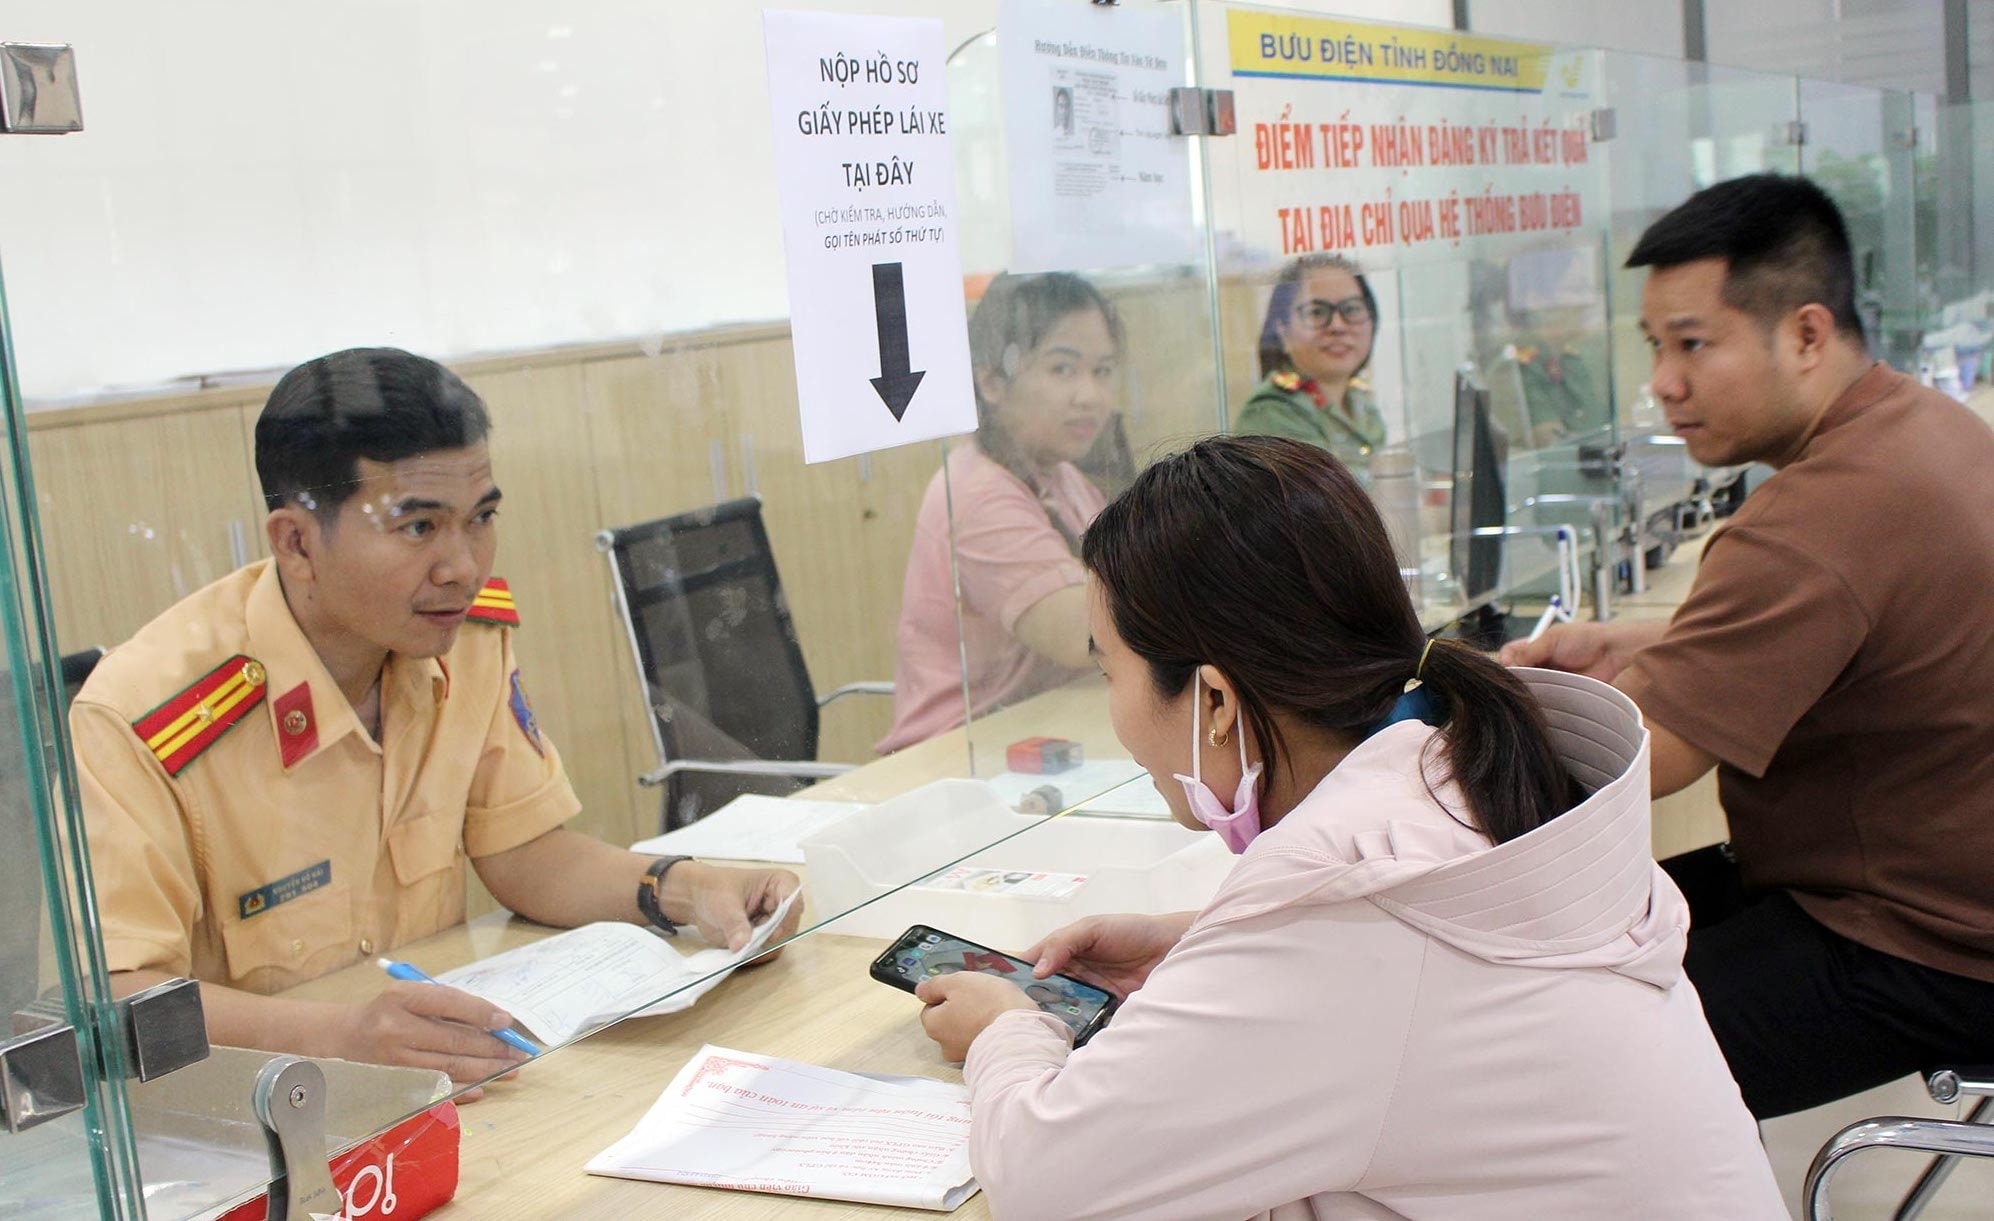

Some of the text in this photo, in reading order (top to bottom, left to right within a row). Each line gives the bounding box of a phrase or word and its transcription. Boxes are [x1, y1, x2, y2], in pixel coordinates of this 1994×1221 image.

[819, 50, 920, 88] NỘP HỒ SƠ
[1260, 33, 1519, 77] BƯU ĐIỆN TỈNH ĐỒNG NAI
[798, 101, 946, 135] GIẤY PHÉP LÁI XE
[1256, 103, 1314, 170] ĐIỂM
[1320, 109, 1363, 169] TIẾP
[1371, 116, 1424, 176] NHẬN
[1428, 117, 1475, 166] ĐĂNG
[1478, 118, 1498, 165] KÝ
[1502, 115, 1531, 165] TRẢ
[1533, 115, 1558, 165] KẾT
[842, 155, 914, 192] TẠI ĐÂY
[864, 208, 885, 222] TRA,
[887, 203, 926, 220] HƯỚNG
[1278, 207, 1314, 260] TẠI
[1320, 204, 1356, 259] ĐỊA
[1361, 187, 1395, 246] CHỈ
[1400, 198, 1435, 248] QUA
[1438, 189, 1461, 246] HỆ
[1464, 182, 1516, 236] THỐNG
[824, 235, 841, 251] GỌI
[844, 231, 861, 247] TÊN
[863, 230, 887, 246] PHÁT
[889, 226, 903, 244] SỐ
[905, 226, 927, 243] THỨ
[734, 1087, 758, 1099] của
[759, 1095, 789, 1106] toàn
[785, 1184, 810, 1194] Giáo
